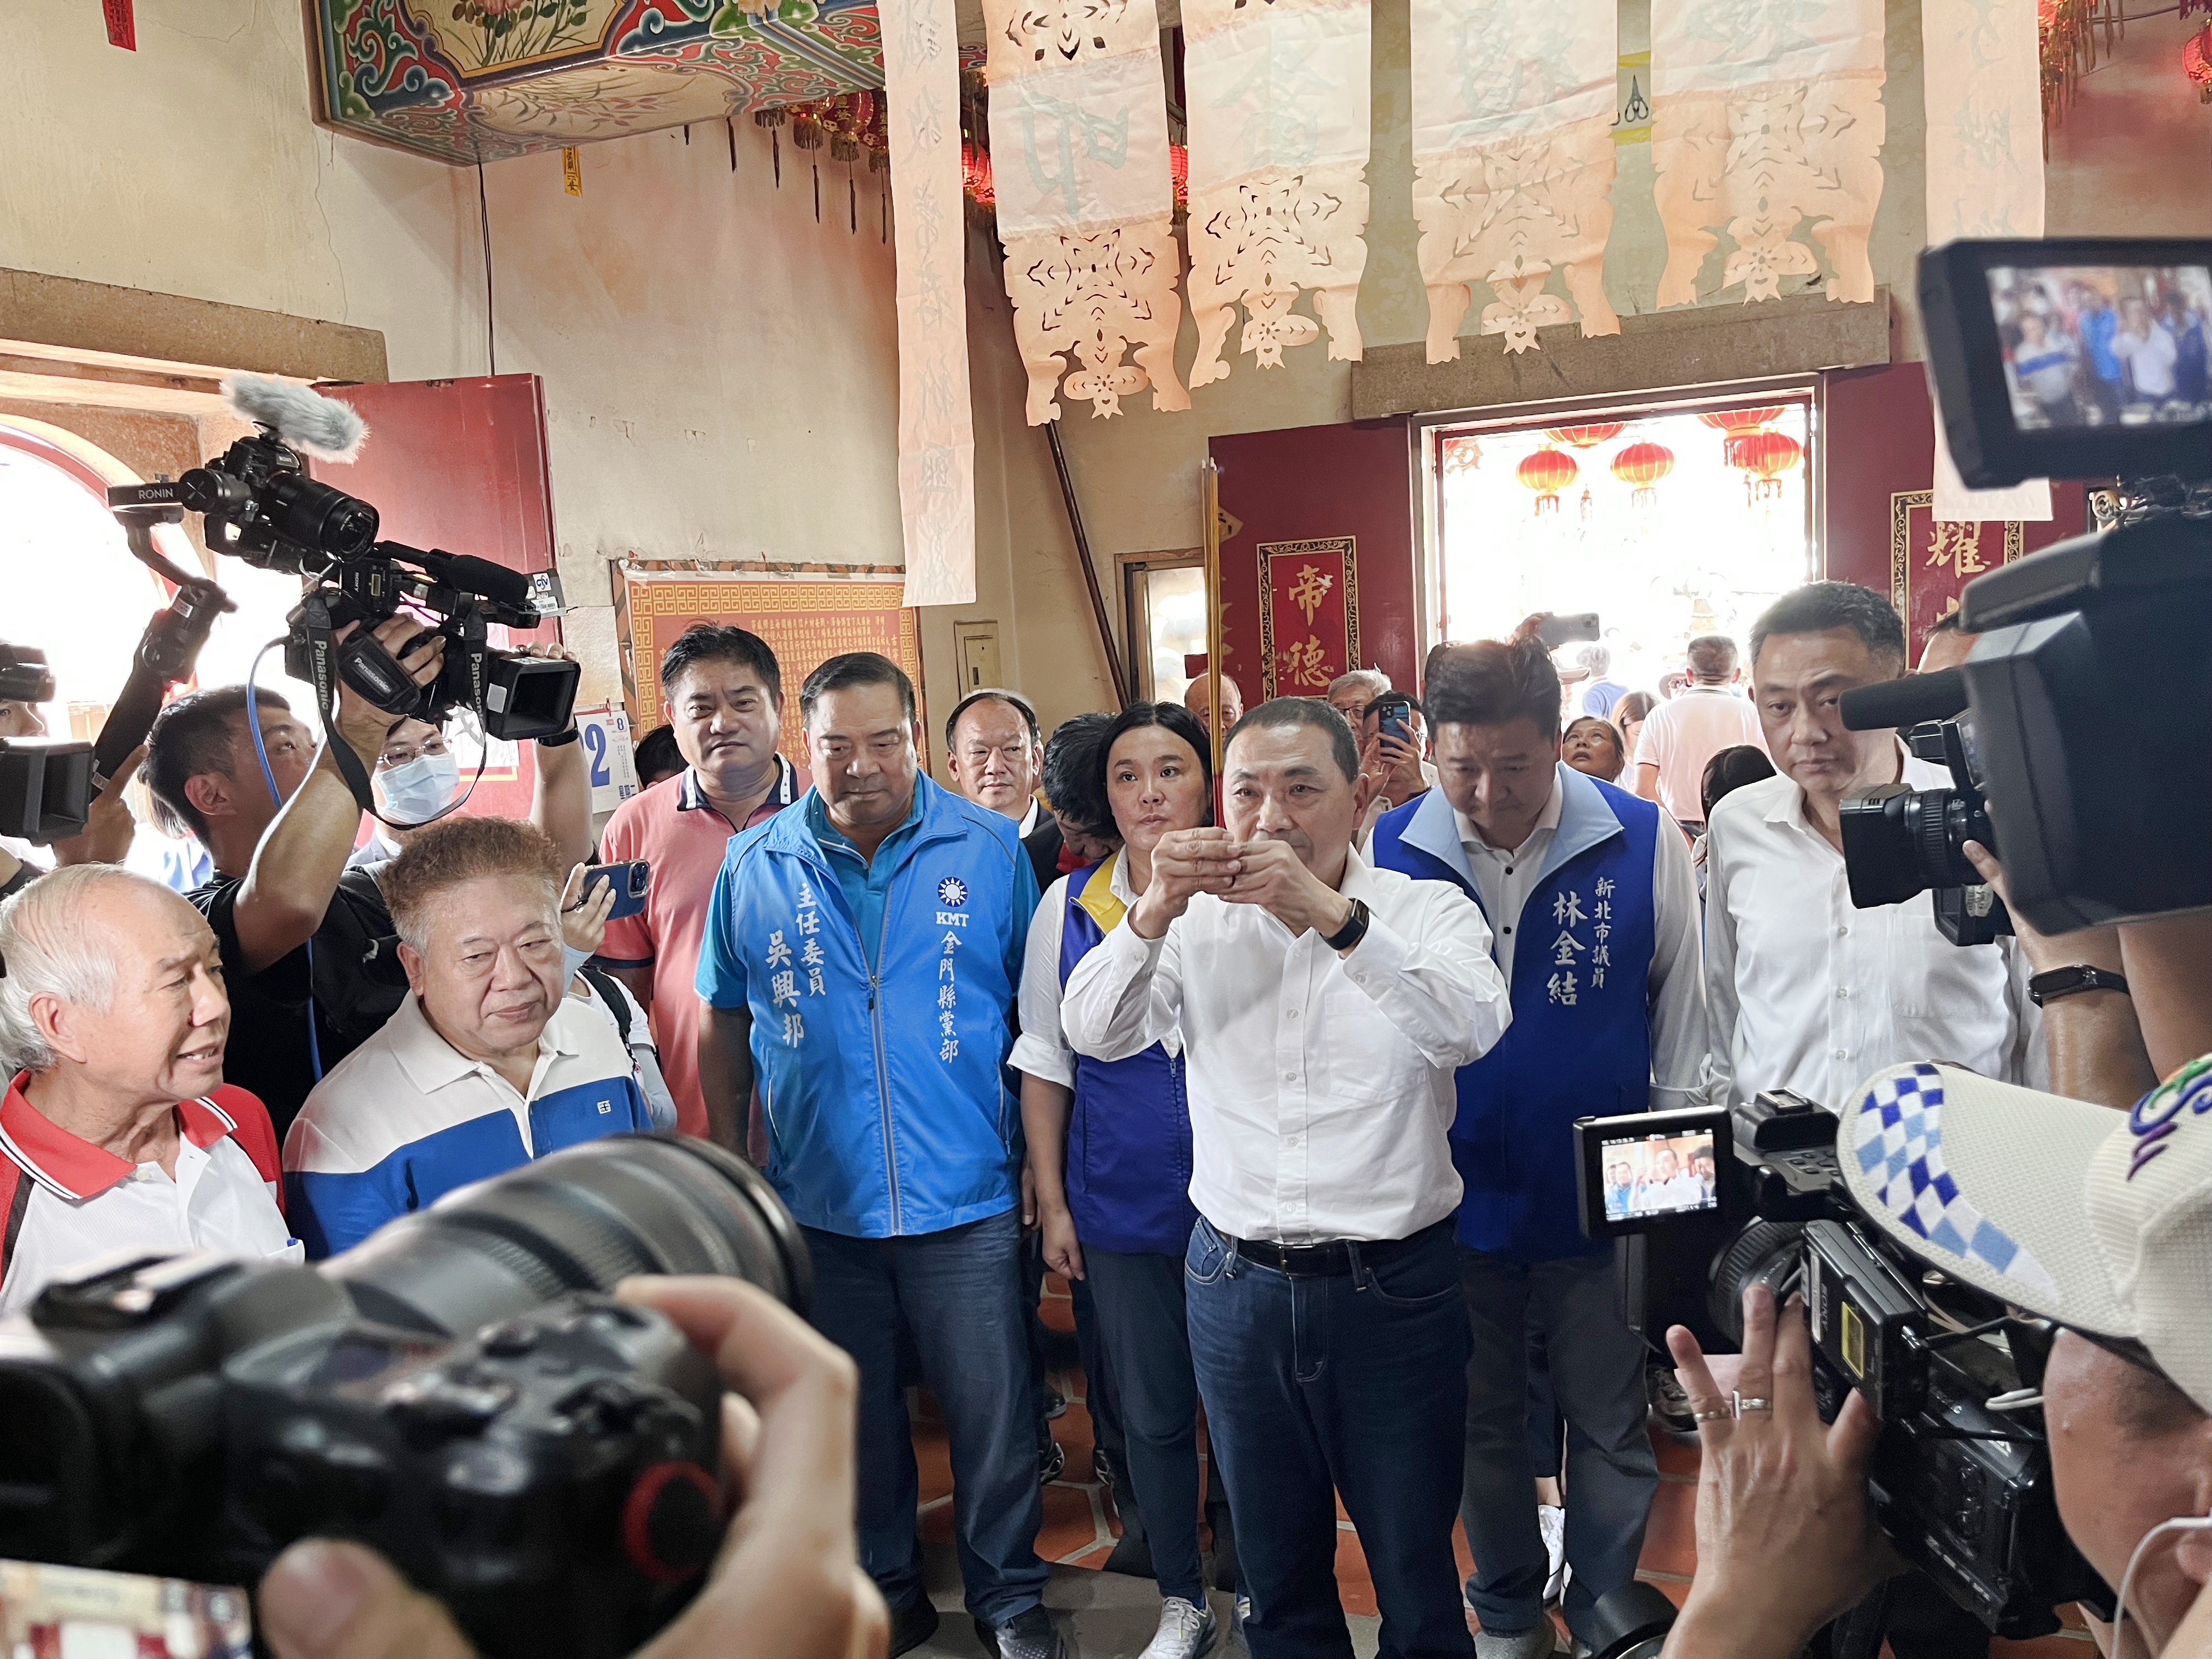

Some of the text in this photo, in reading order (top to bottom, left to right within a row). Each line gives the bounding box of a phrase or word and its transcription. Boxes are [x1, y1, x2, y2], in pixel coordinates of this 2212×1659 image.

[138, 487, 174, 500] RONIN
[1288, 564, 1335, 687] 帝德
[314, 640, 329, 711] Panasonic
[353, 656, 392, 694] Panasonic
[578, 723, 611, 788] 2
[616, 718, 625, 731] 8
[795, 883, 826, 997] 主任委員
[935, 911, 969, 928] KMT
[1547, 891, 1588, 1006] 林金結
[1590, 877, 1616, 989] 新北市議員
[765, 929, 805, 1048] 吳興邦
[936, 930, 962, 1064] 金門縣黨部
